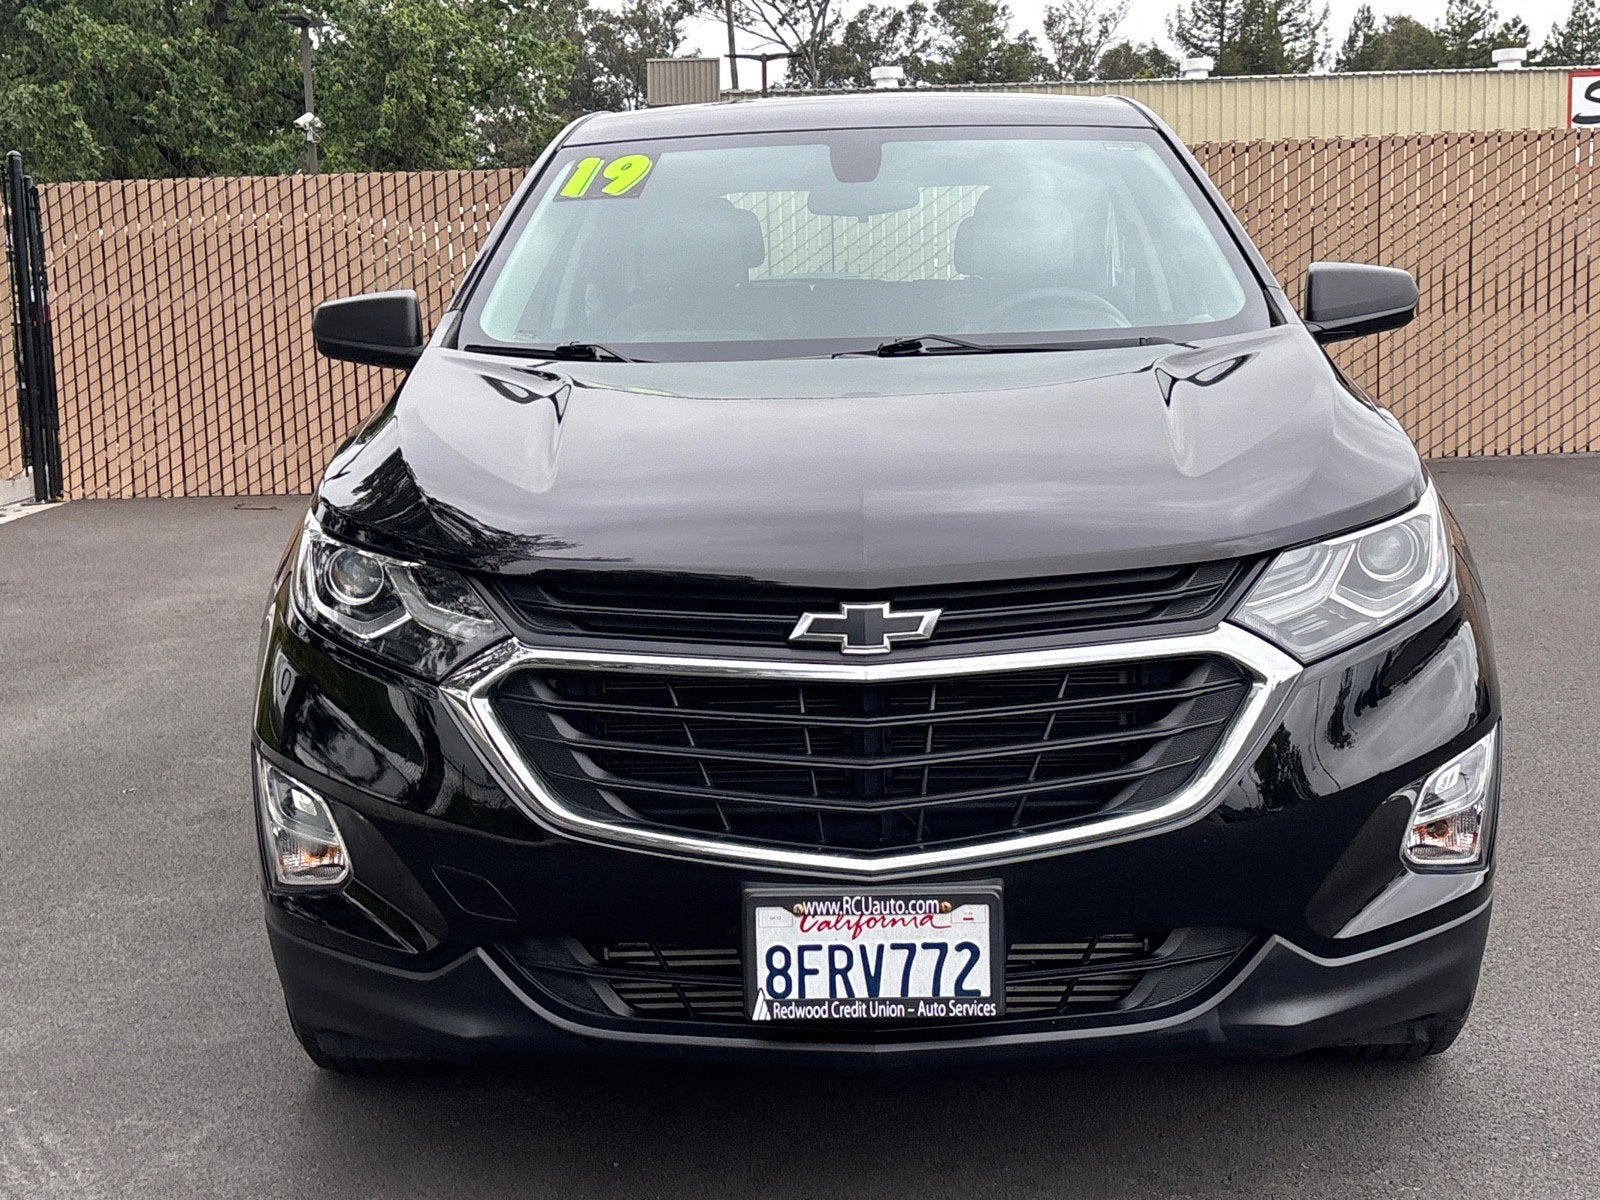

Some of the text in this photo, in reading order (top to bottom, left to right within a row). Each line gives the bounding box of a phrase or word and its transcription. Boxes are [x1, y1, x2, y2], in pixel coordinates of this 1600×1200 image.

[560, 154, 653, 198] 19
[803, 896, 940, 915] www.RCUauto.com
[799, 913, 952, 940] California
[765, 941, 982, 999] 8FRV772
[773, 1002, 829, 1019] Redwood
[831, 1001, 868, 1018] Credit
[871, 1001, 905, 1017] Union
[917, 1001, 946, 1016] Auto
[948, 1000, 996, 1016] Services
